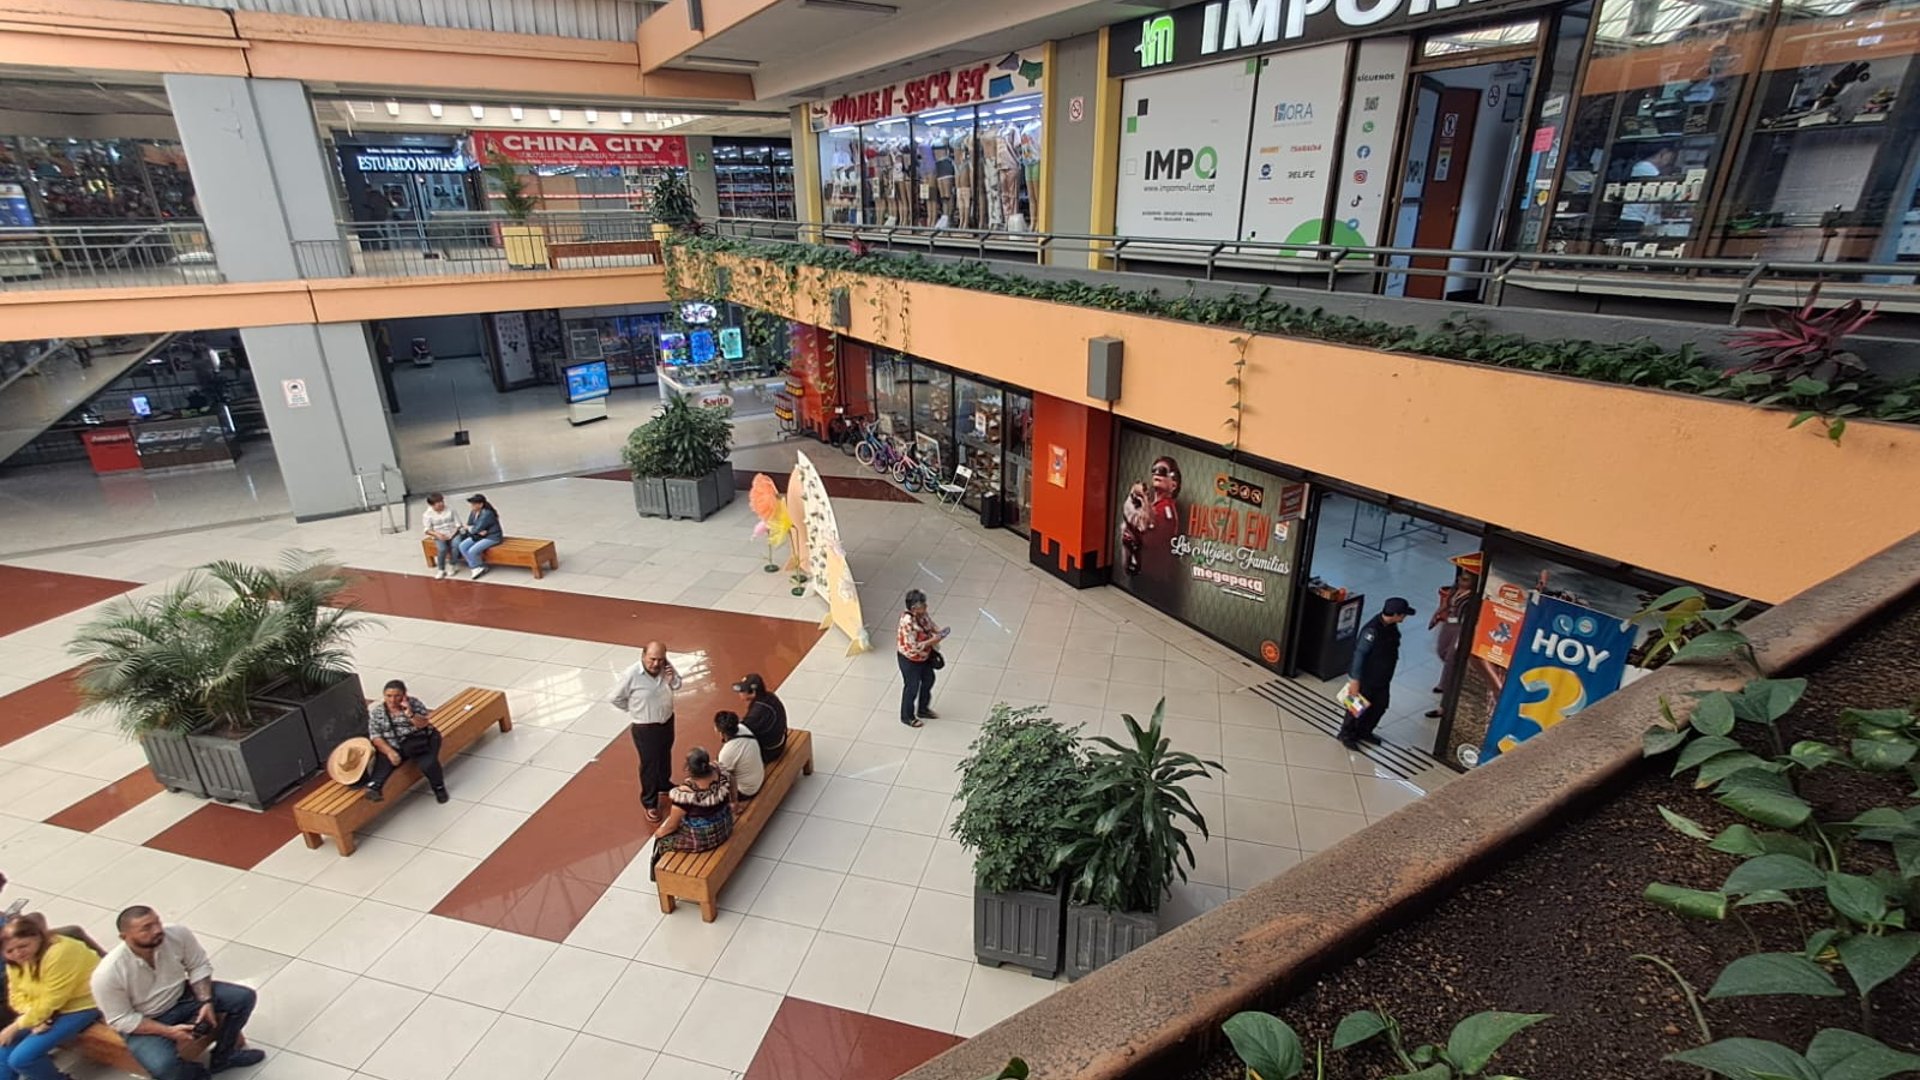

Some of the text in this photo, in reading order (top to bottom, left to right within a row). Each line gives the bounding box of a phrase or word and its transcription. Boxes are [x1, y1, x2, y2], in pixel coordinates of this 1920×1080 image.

[503, 136, 664, 152] CHINA CITY
[357, 155, 415, 172] ESTUARDO
[1188, 504, 1239, 546] HASTA
[1245, 511, 1271, 551] EN
[1171, 535, 1192, 556] Las
[1236, 547, 1289, 574] Familias
[1192, 565, 1264, 592] megapaca
[1531, 628, 1611, 673] HOY
